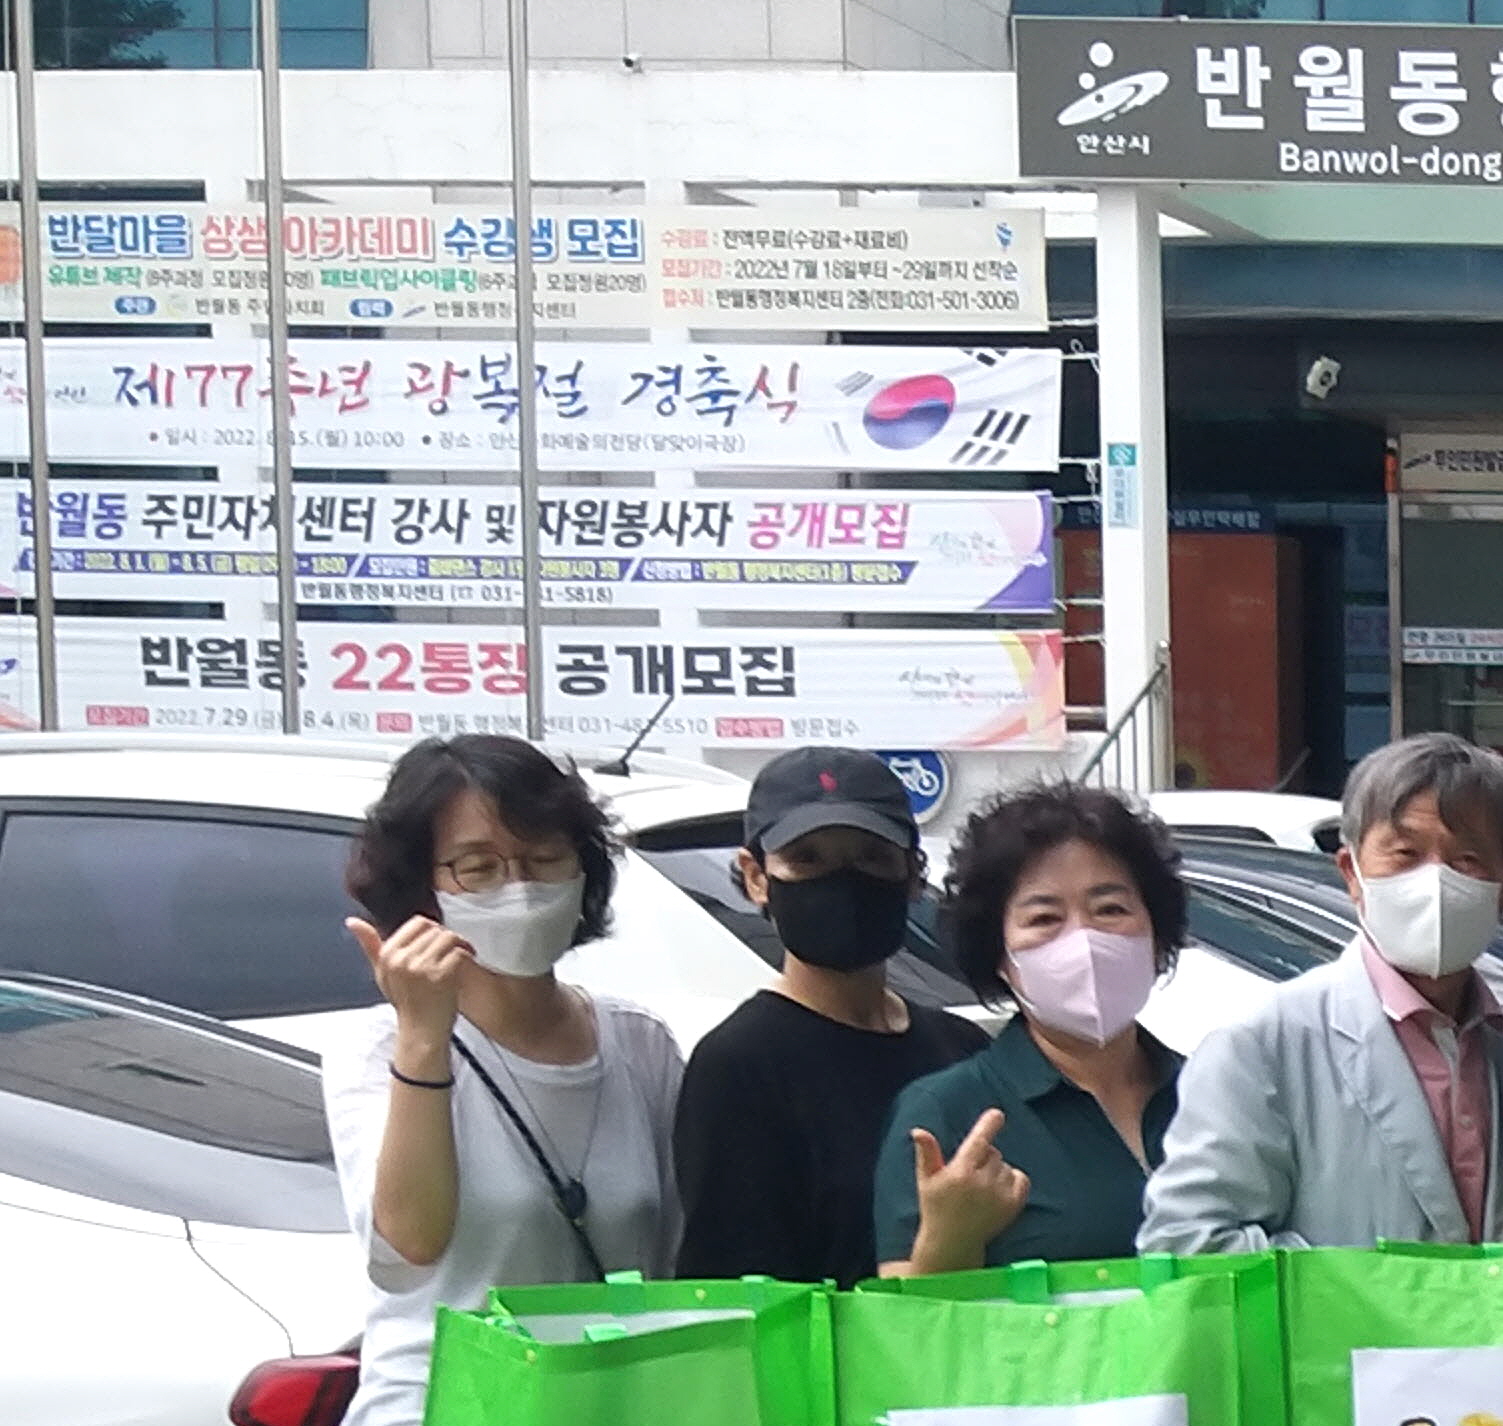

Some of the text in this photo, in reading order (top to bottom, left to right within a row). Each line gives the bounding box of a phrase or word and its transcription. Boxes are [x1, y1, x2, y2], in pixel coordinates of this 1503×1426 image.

[1076, 133, 1150, 156] 안산시
[1281, 142, 1503, 183] Banwol-dong
[47, 213, 192, 258] 반달마을
[281, 215, 433, 259] 아카데미
[566, 217, 643, 260] 모집
[404, 352, 590, 426] 광복절
[621, 354, 801, 428] 경축식
[391, 497, 471, 545] 강사
[485, 503, 516, 544] 및
[538, 500, 734, 549] 자원봉사자
[746, 502, 911, 550] 공개모집
[141, 635, 797, 698] 반월동 22통장 공개모집
